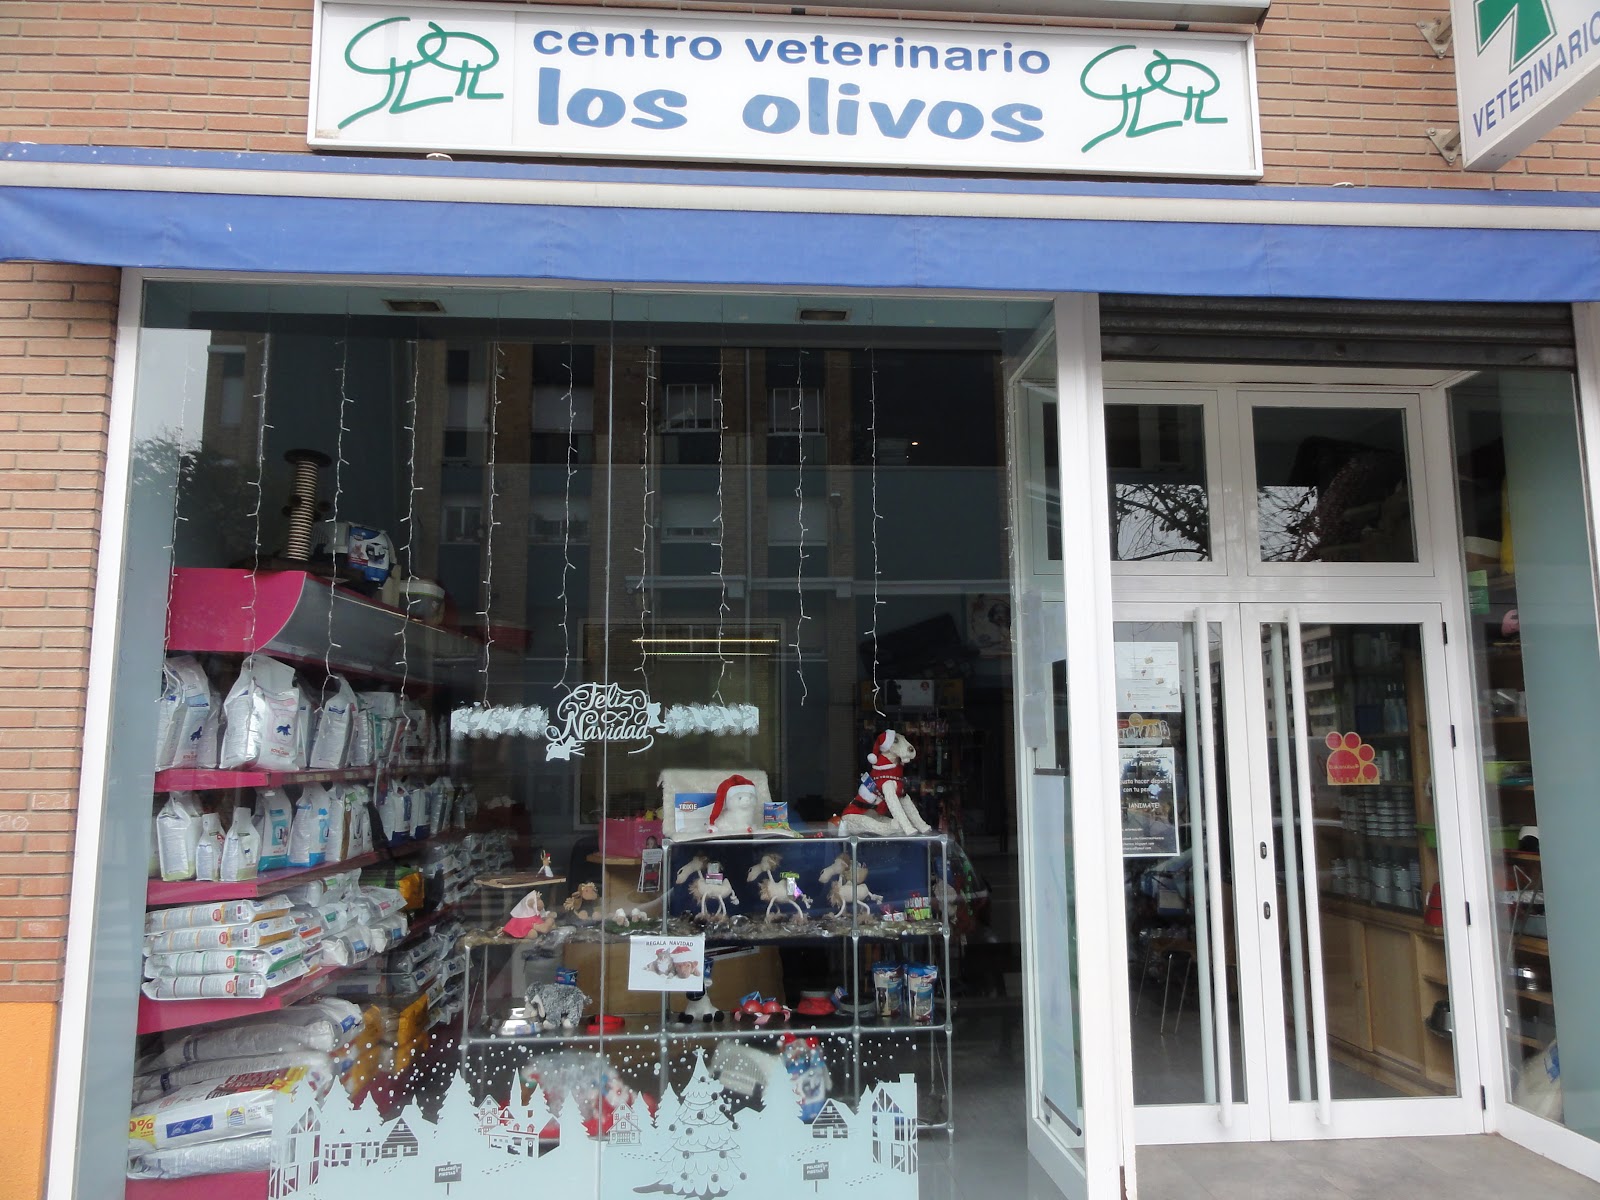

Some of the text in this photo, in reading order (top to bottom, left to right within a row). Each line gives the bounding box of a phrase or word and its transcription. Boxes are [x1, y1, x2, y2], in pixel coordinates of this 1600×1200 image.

[534, 29, 1050, 74] centro veterinario
[539, 67, 1044, 142] los olivos
[560, 710, 651, 741] Navidad
